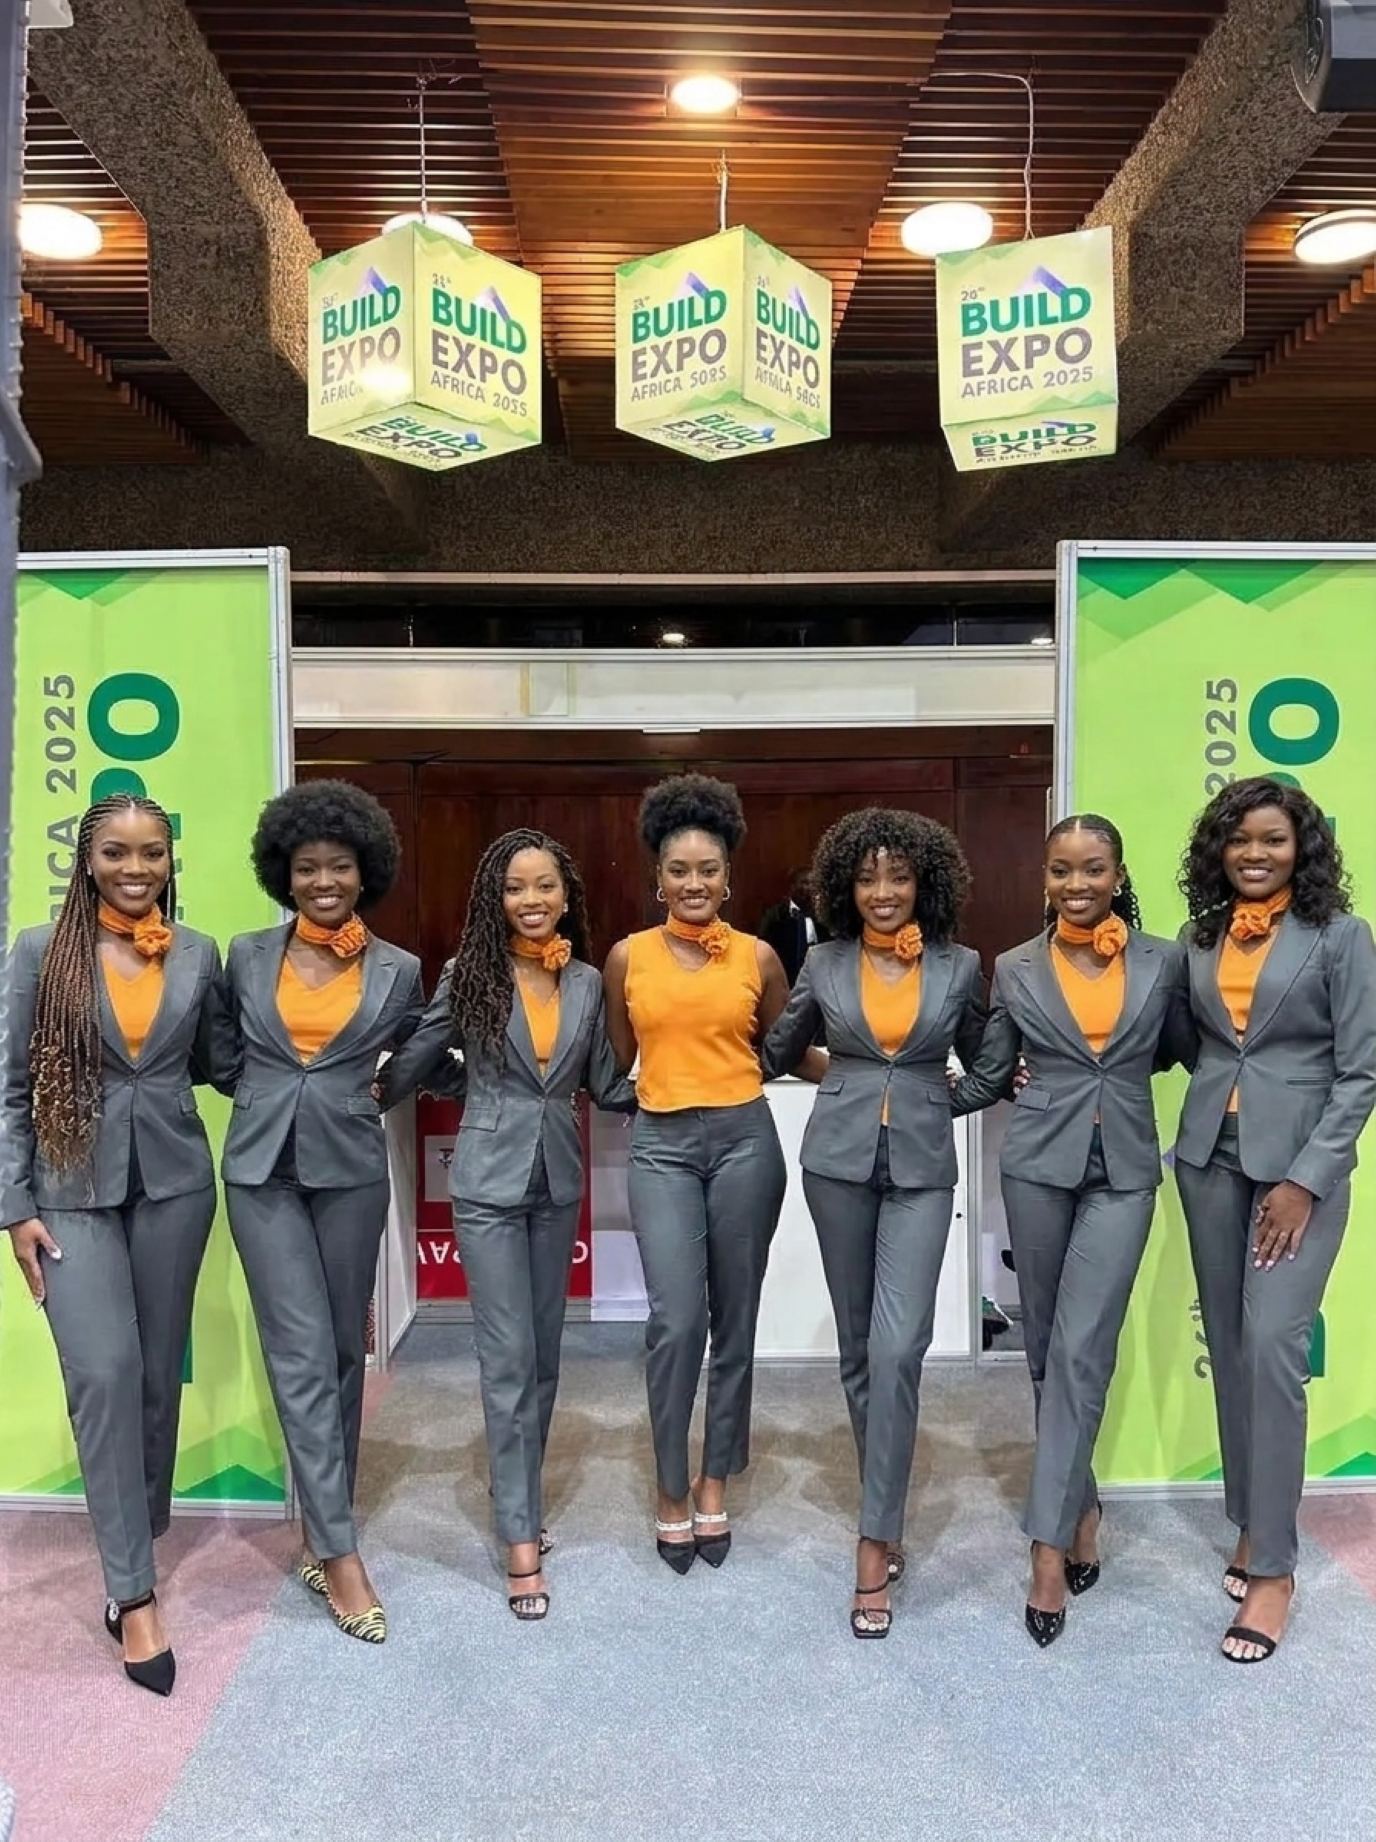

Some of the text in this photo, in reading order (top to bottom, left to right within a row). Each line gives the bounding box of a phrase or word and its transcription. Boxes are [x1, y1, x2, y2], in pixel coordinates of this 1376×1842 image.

[323, 285, 401, 345] BUILD
[432, 287, 527, 354] BUILD
[632, 289, 727, 344] BUILD
[756, 287, 820, 351] BUILD
[961, 286, 1092, 337] BUILD
[322, 326, 401, 386] EXPO
[432, 328, 527, 396] EXPO
[632, 328, 727, 383] EXPO
[756, 326, 820, 389] EXPO
[961, 327, 1093, 378] EXPO
[430, 370, 487, 404] AFRICA
[631, 376, 683, 402] AFRICA
[960, 365, 1094, 399] AFRICA 2025
[43, 674, 77, 795] 2025
